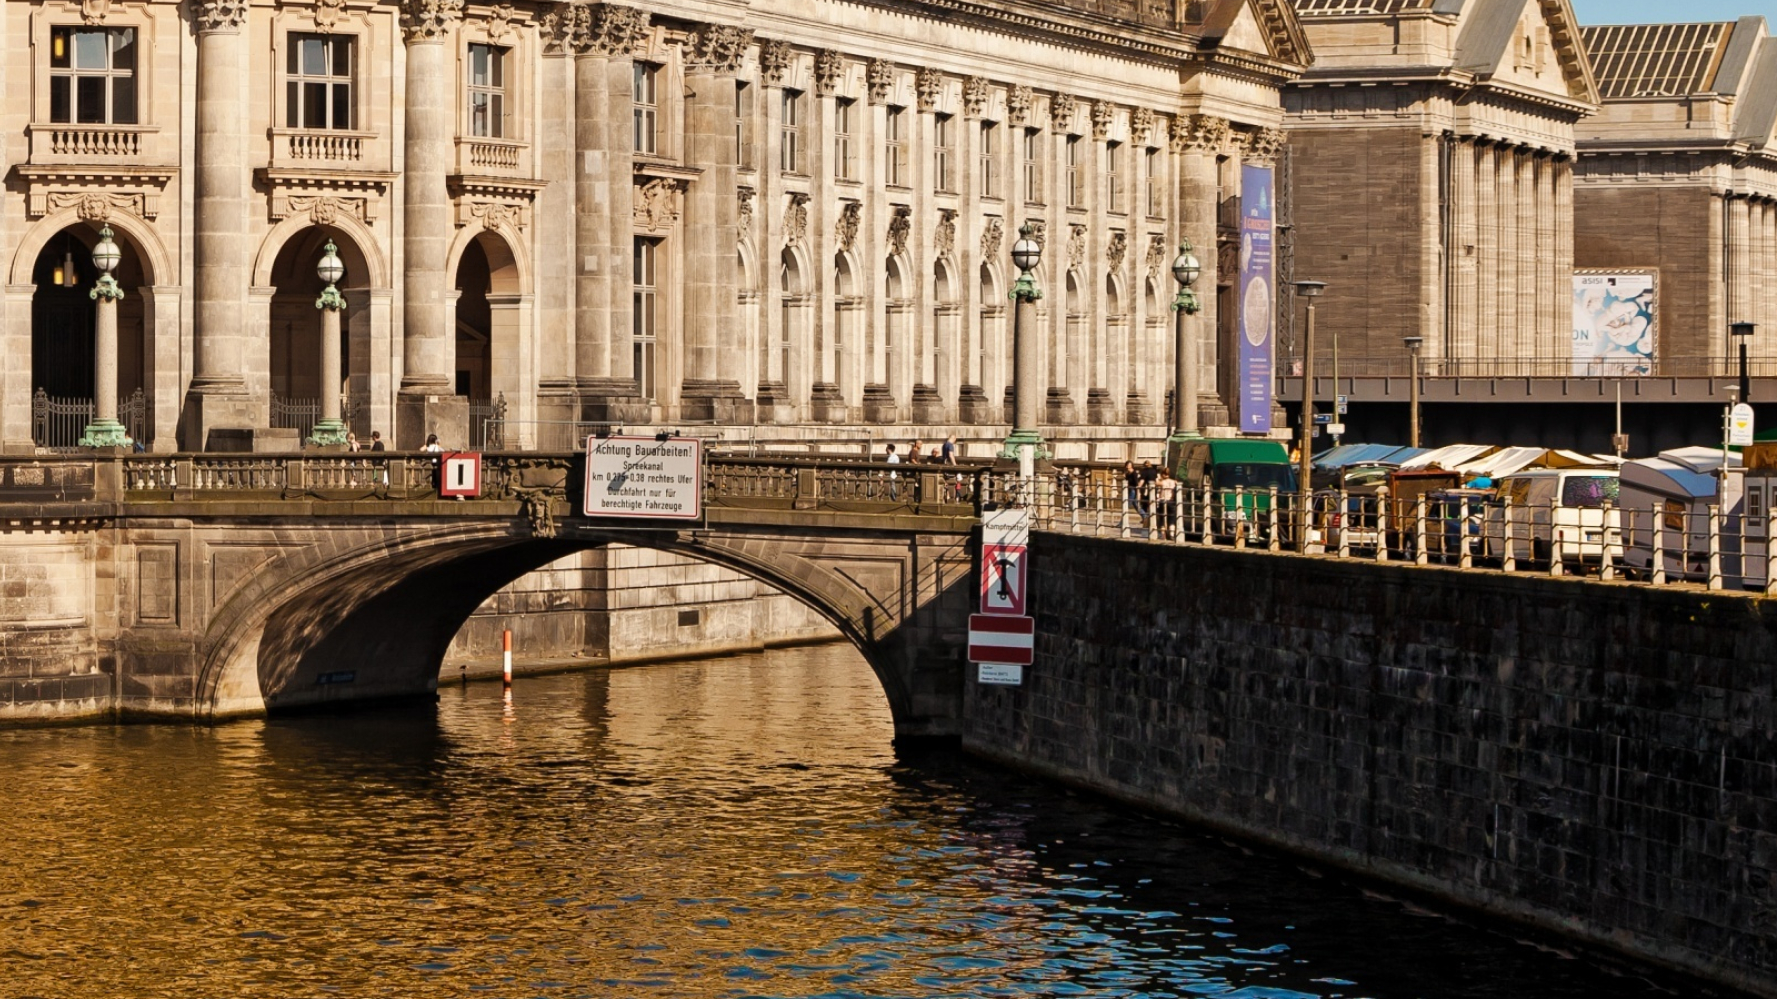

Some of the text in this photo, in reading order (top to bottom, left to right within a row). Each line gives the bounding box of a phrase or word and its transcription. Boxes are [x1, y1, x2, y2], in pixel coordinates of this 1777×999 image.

[596, 444, 692, 457] Achtung Bauarbeiten!
[624, 461, 663, 471] Spreekanal
[648, 474, 674, 483] rechtes
[678, 475, 693, 483] Ufer
[608, 487, 646, 496] Durchfahrt
[666, 489, 676, 497] für
[601, 499, 682, 512] berechtigte Fahrzeuge
